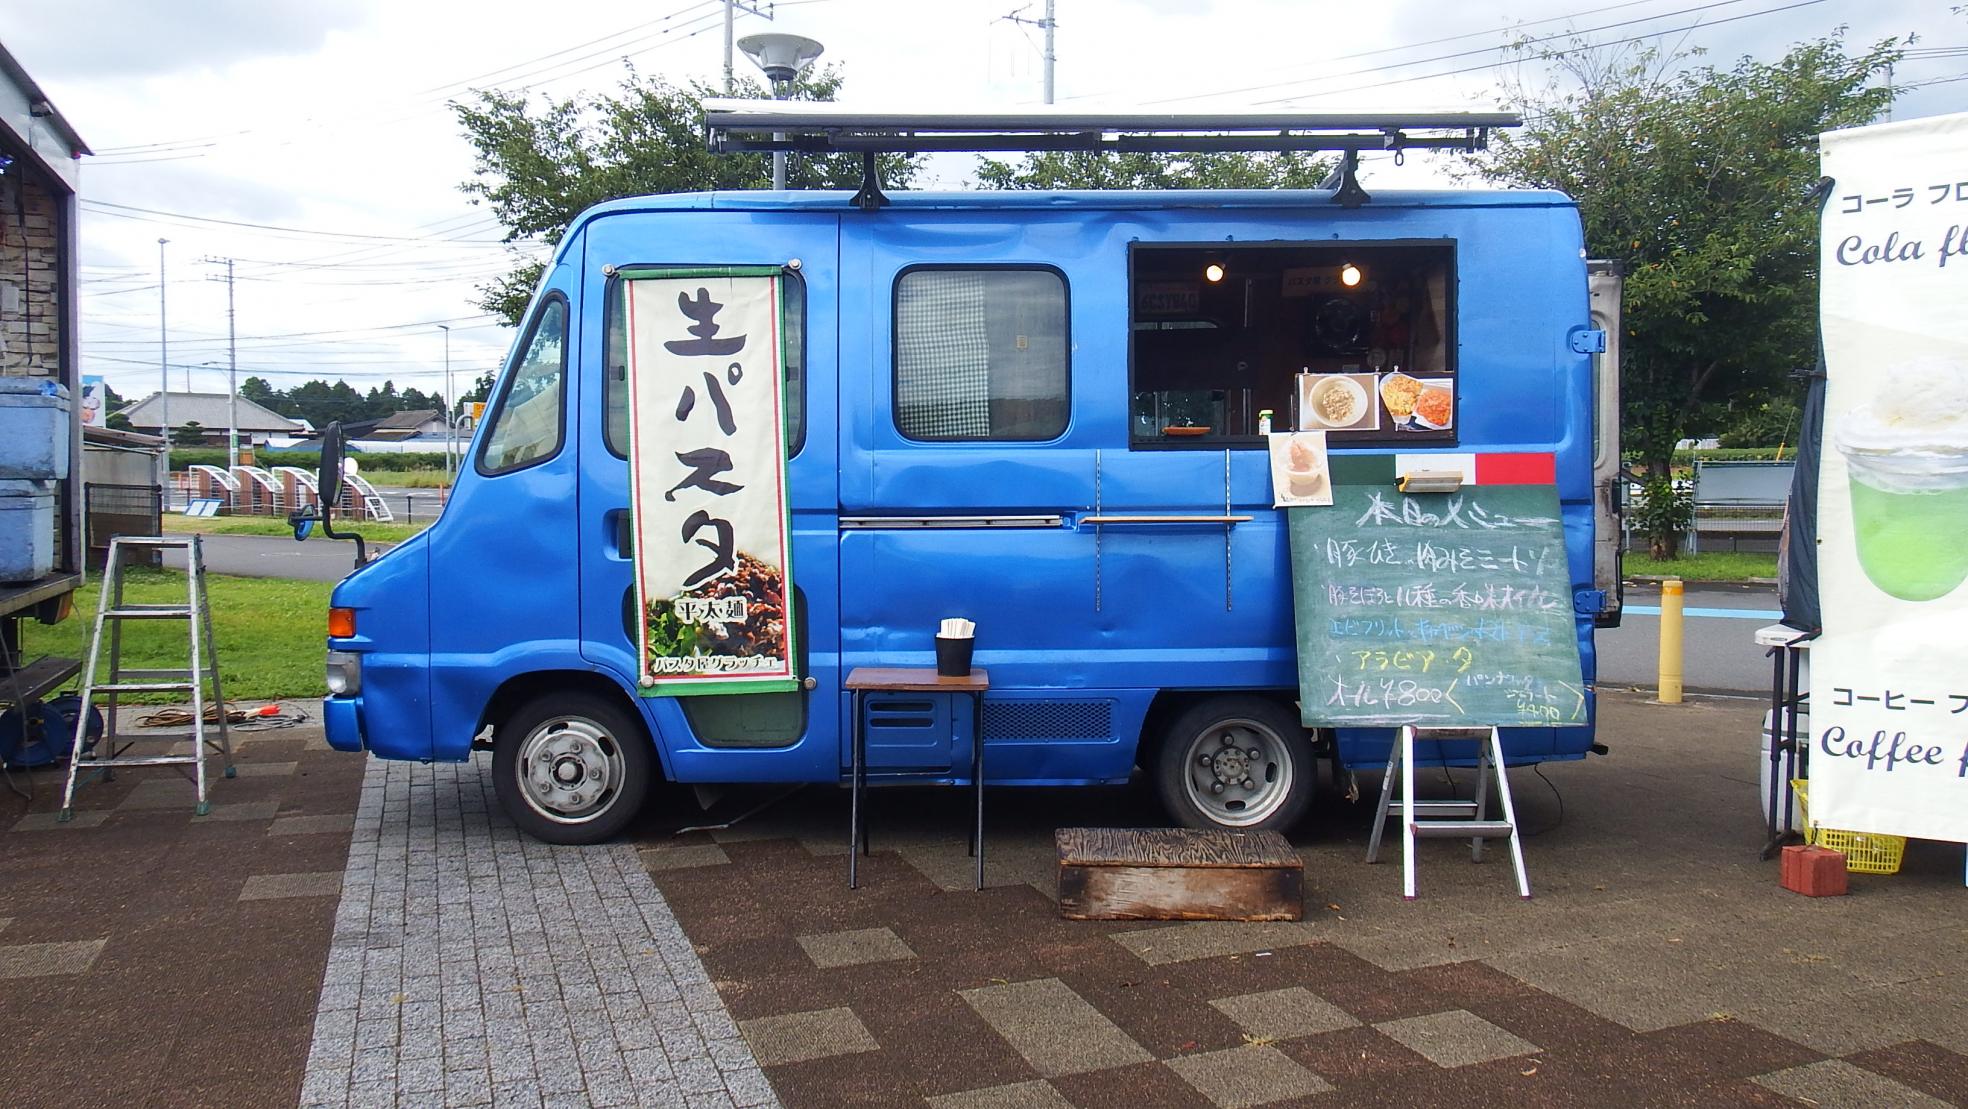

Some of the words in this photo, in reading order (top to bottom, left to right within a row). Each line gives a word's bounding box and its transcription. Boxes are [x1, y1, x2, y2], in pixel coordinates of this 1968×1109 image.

[1843, 187, 1914, 214] コーラ
[1837, 231, 1925, 266] Cola
[664, 287, 747, 587] 生パスタ
[1833, 687, 1935, 711] コーヒー
[1821, 726, 1944, 772] Coffee
